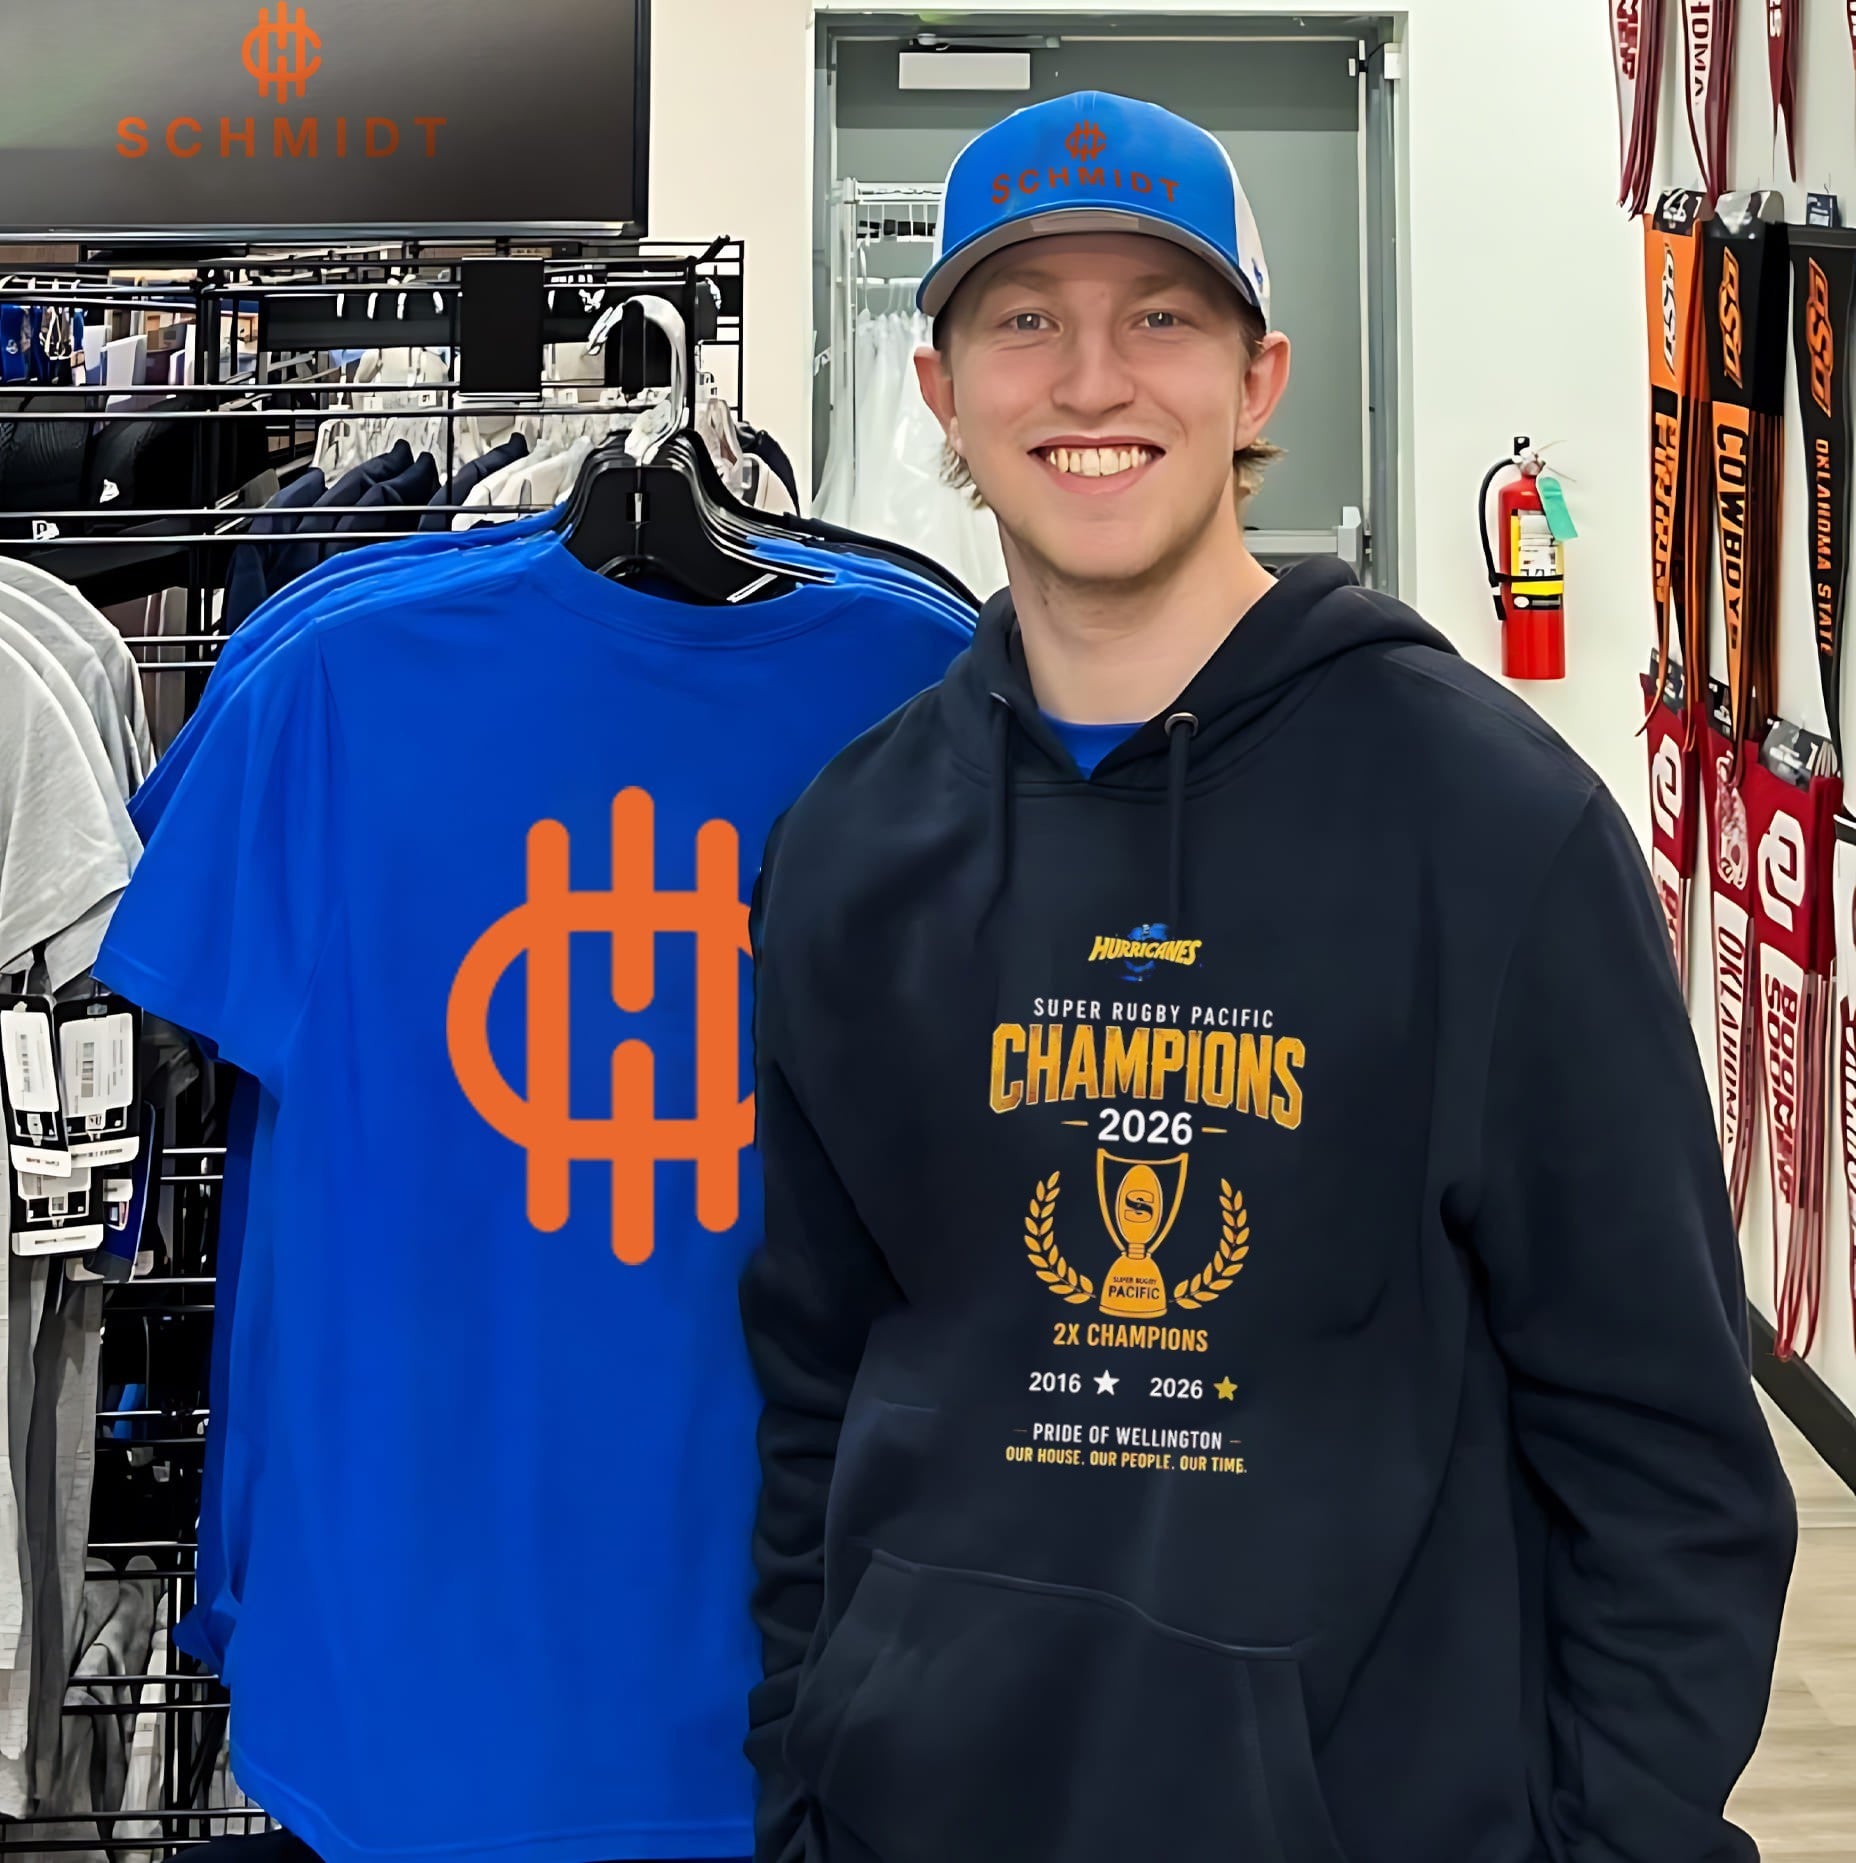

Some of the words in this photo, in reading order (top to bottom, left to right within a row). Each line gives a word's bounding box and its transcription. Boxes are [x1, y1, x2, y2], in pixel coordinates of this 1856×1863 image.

[116, 116, 448, 158] SCHMIDT
[991, 167, 1179, 204] SCHMIDT
[1815, 438, 1832, 570] OKLAHOMA
[1088, 935, 1203, 966] HURRICANES
[1033, 997, 1101, 1020] SUPER
[1112, 1002, 1181, 1024] RUGBY
[1191, 1006, 1274, 1028] PACIFIC
[1718, 925, 1745, 1144] OKLAHOMA
[989, 1022, 1306, 1131] CHAMPIONS
[1097, 1107, 1194, 1146] 2026
[1108, 1285, 1160, 1300] PACIFIC
[1112, 1276, 1134, 1284] SUPER
[1053, 1322, 1080, 1346] 2X
[1087, 1323, 1209, 1353] CHAMPIONS
[1028, 1371, 1082, 1394] 2016
[1149, 1377, 1204, 1400] 2026
[1032, 1422, 1083, 1444] PRIDE
[1088, 1425, 1110, 1445] OF
[1116, 1426, 1223, 1451] WELLINGTON
[1005, 1446, 1033, 1463] OUR
[1037, 1447, 1085, 1466] HOUSE.
[1089, 1451, 1117, 1467] OUR
[1121, 1452, 1175, 1470] PEOPLE.
[1179, 1455, 1208, 1471] OUR
[1211, 1456, 1248, 1474] TIME.
